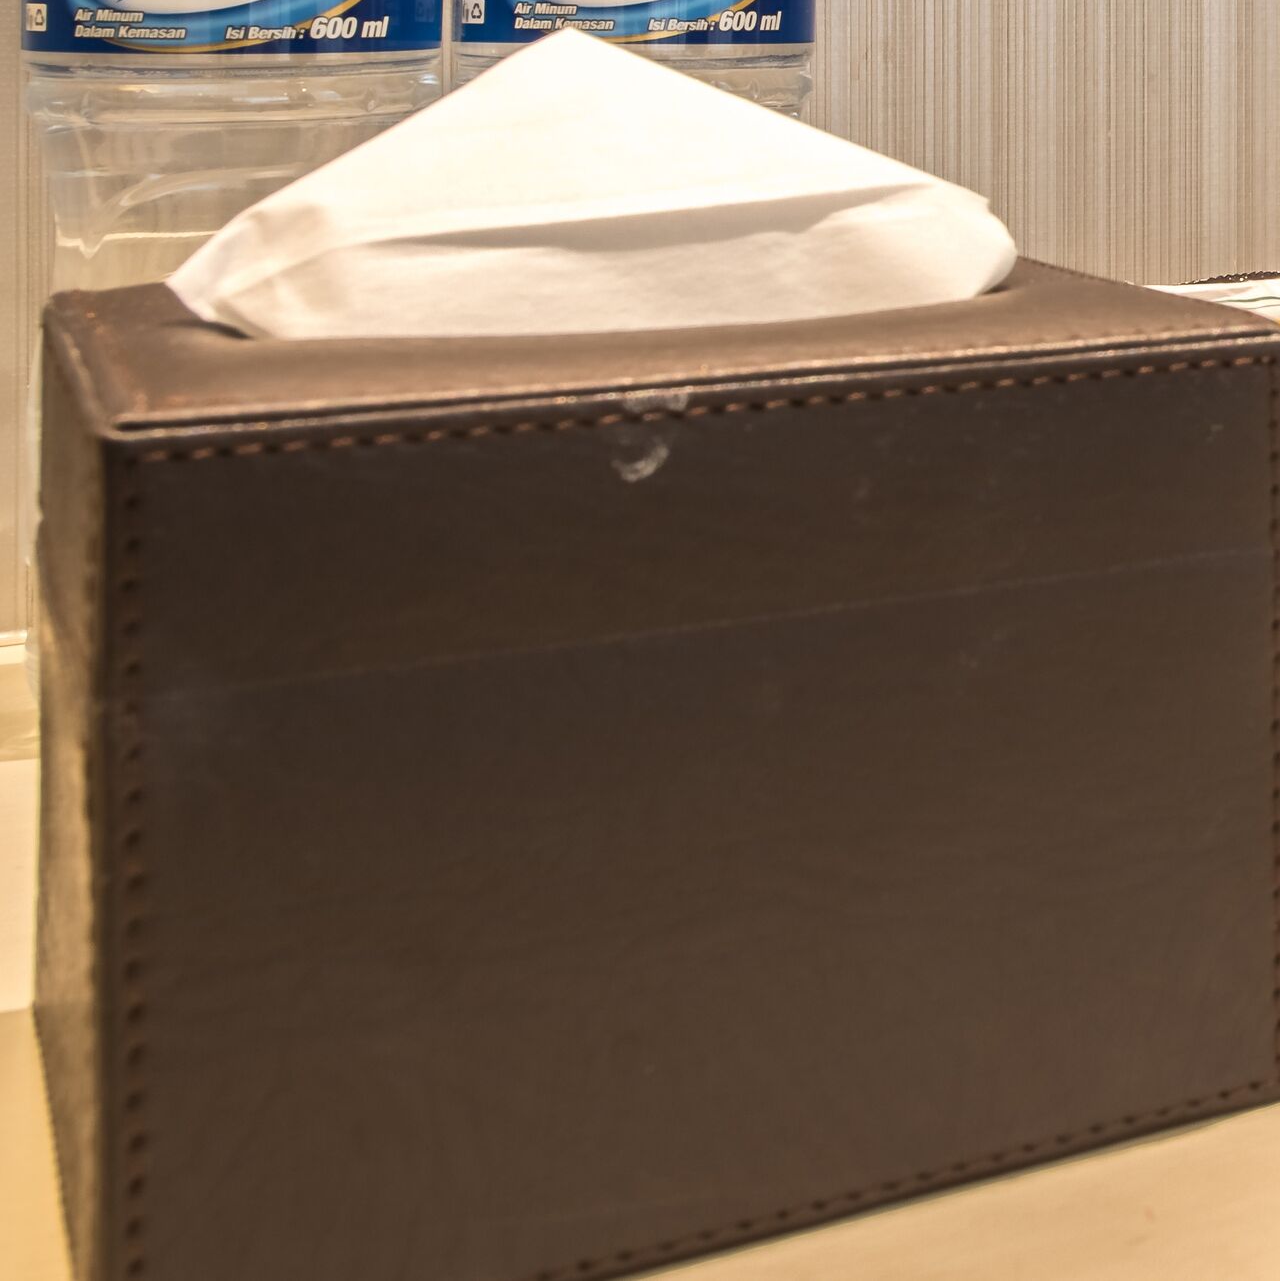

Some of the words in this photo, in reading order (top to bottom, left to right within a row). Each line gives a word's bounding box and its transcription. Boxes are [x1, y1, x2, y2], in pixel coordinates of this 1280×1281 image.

[74, 8, 94, 22] Air
[95, 8, 144, 23] Minum
[514, 2, 533, 15] Air
[534, 2, 578, 15] Minum
[225, 25, 246, 40] Isi
[310, 16, 358, 39] 600
[360, 15, 390, 39] ml
[514, 17, 552, 30] Dalam
[648, 18, 666, 31] Isi
[719, 10, 758, 32] 600
[760, 10, 782, 31] ml
[74, 24, 116, 38] Dalam
[118, 25, 187, 39] Kemasan
